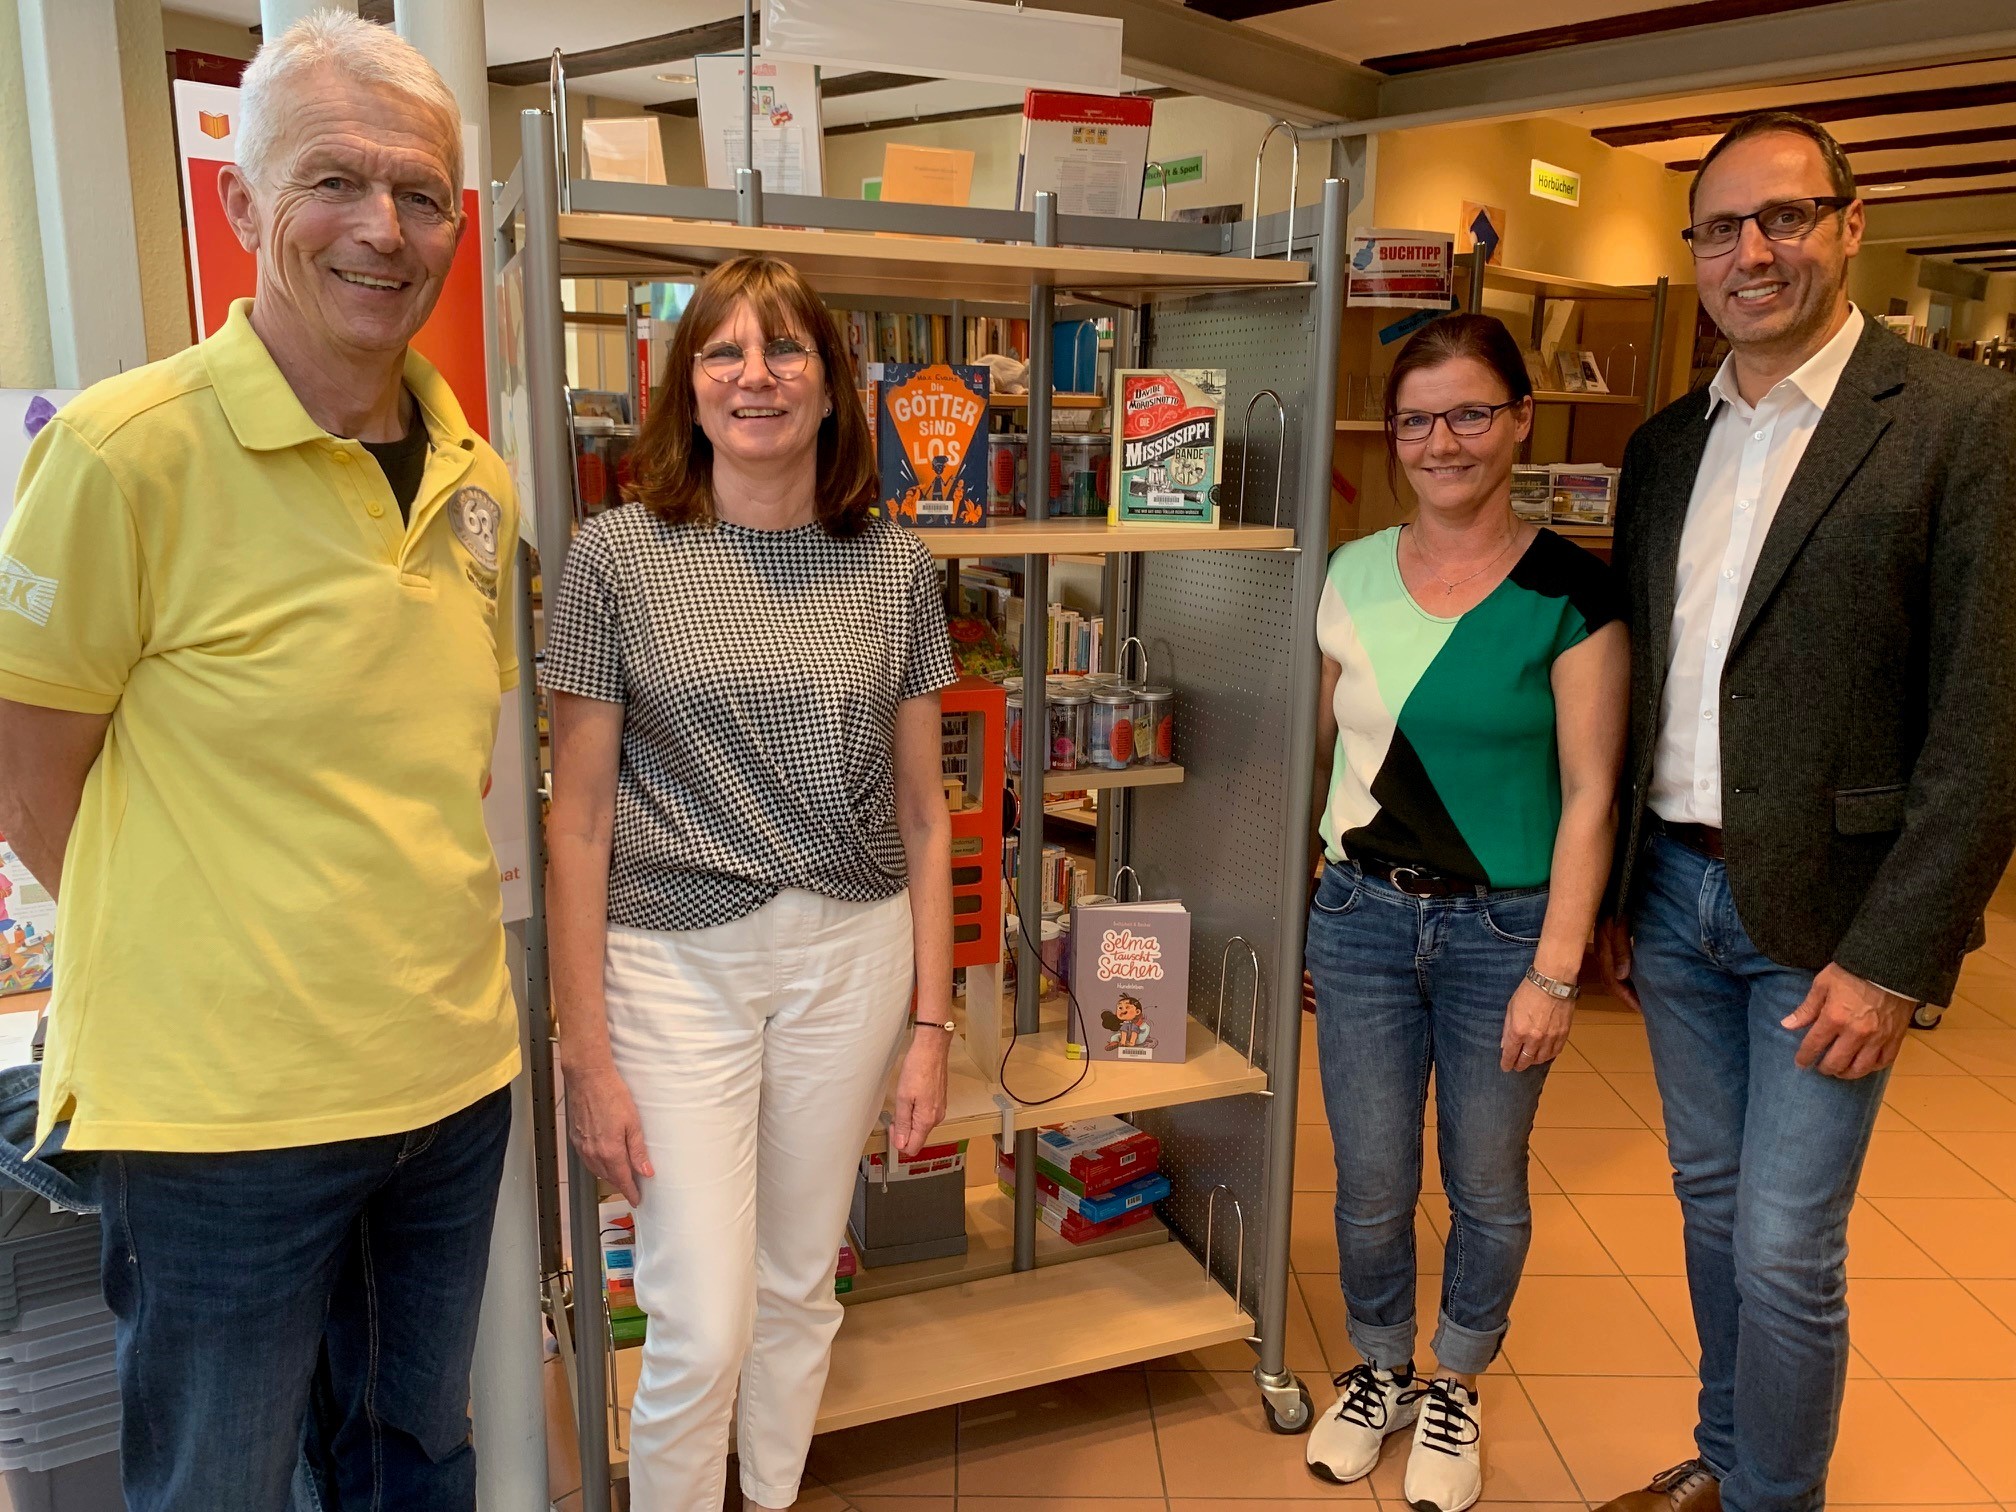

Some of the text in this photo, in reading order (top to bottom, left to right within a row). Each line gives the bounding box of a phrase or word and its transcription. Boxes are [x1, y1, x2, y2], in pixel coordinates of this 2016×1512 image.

[1180, 164, 1199, 176] Sport
[1538, 174, 1574, 195] Hörbücher
[1379, 245, 1441, 261] BUCHTIPP
[931, 383, 944, 392] Die
[1135, 384, 1161, 399] DAVIDE
[894, 388, 979, 427] GÖTTER
[1128, 396, 1179, 410] MOROSINOTTO
[1140, 418, 1150, 427] DIE
[913, 438, 960, 467] LOS
[1175, 448, 1204, 460] BANDE
[463, 499, 495, 554] 68
[1103, 931, 1159, 952] Selma
[1110, 950, 1160, 962] tauscht
[1099, 956, 1162, 979] Sachen
